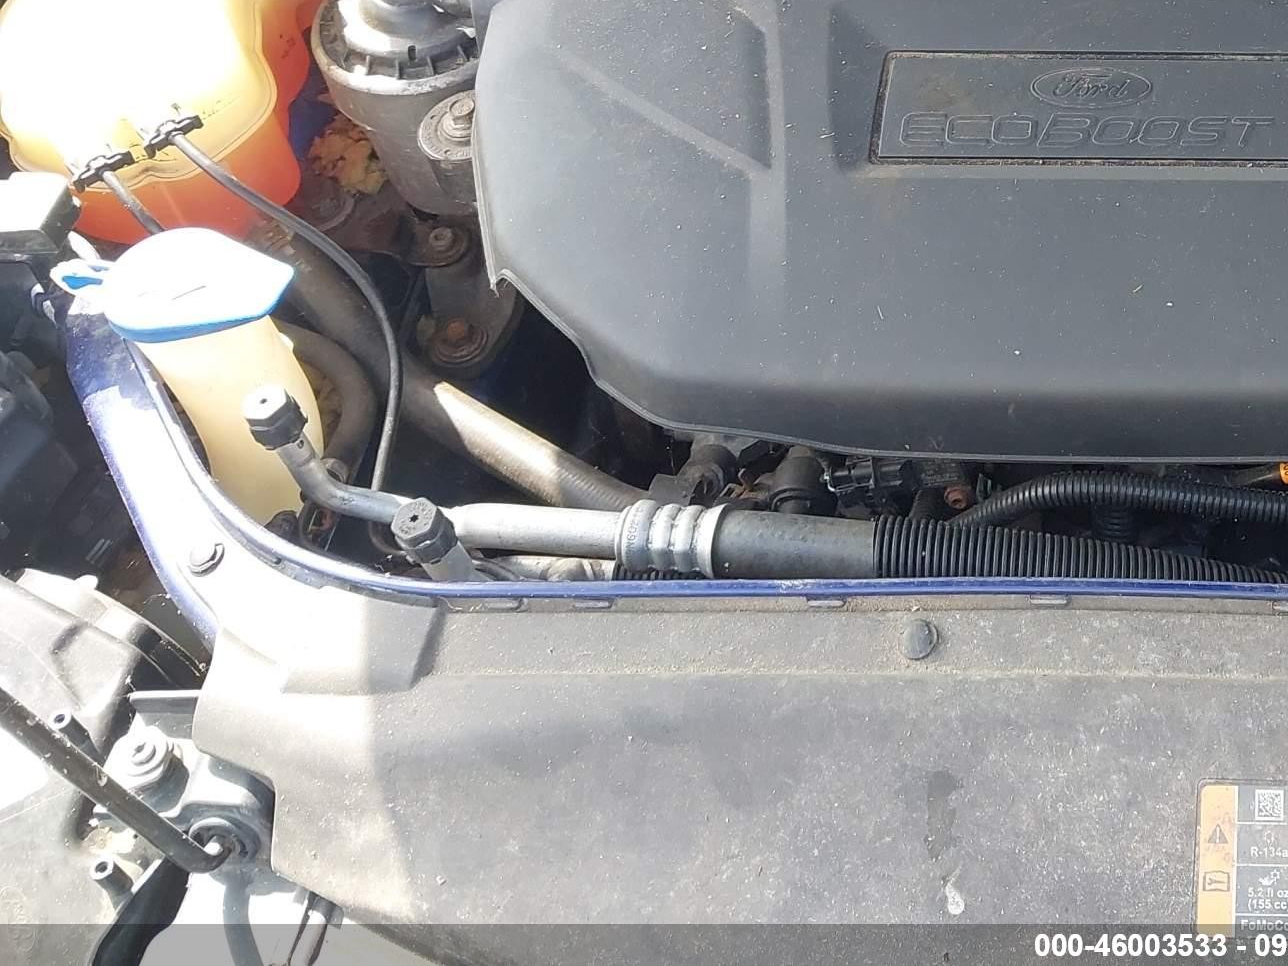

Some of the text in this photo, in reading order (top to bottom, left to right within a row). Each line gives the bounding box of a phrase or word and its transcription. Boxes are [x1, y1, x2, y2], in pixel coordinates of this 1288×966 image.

[1052, 71, 1129, 98] Ford
[1250, 846, 1288, 858] R-134a
[1247, 886, 1265, 898] 5.2
[1266, 886, 1274, 898] fl
[1247, 898, 1272, 912] (155
